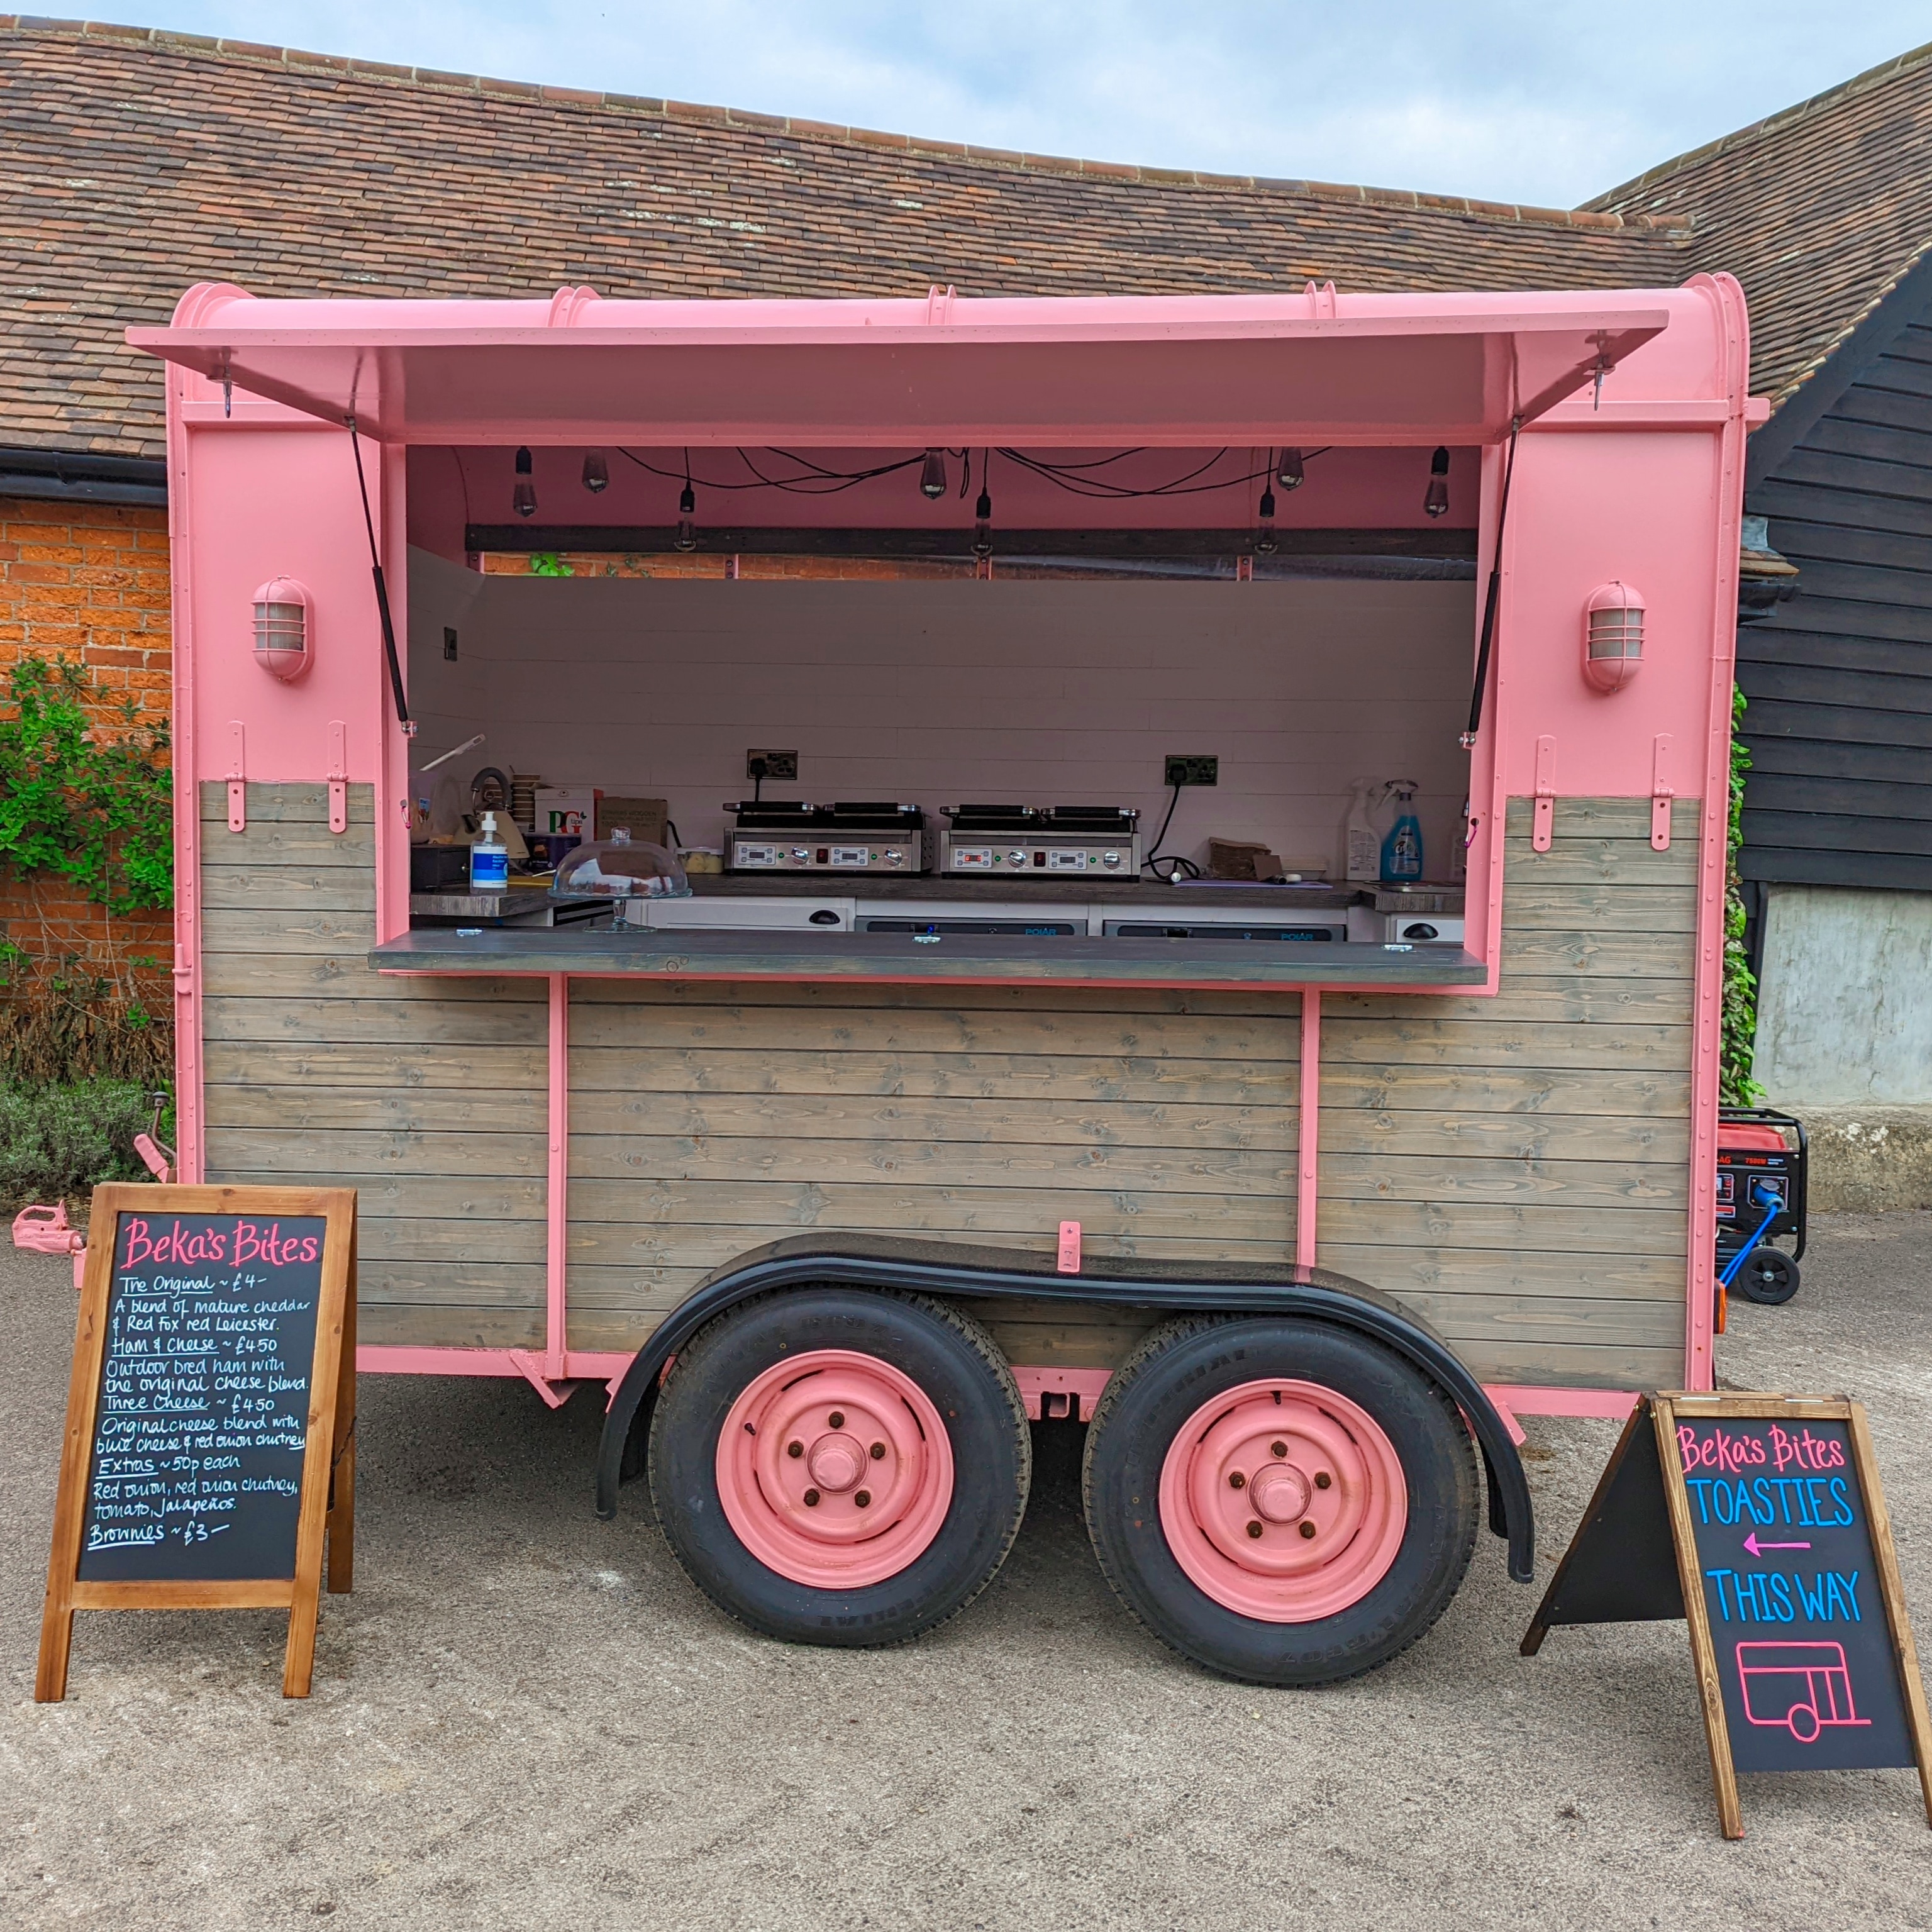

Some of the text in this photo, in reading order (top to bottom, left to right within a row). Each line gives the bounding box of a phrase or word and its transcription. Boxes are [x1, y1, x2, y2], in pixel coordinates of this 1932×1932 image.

[547, 811, 580, 833] PG
[120, 1218, 318, 1269] Beka's Bites
[119, 1277, 148, 1293] The
[153, 1275, 215, 1298] Original
[115, 1299, 311, 1319] A blend of mature cheddar
[127, 1317, 153, 1332] Red
[158, 1316, 179, 1333] Fox
[187, 1317, 210, 1331] red
[111, 1337, 148, 1355] Ham
[167, 1337, 218, 1352] Cheese
[106, 1355, 285, 1377] Outdoor bred ham with
[104, 1377, 133, 1393] the
[140, 1376, 209, 1397] original
[214, 1376, 265, 1391] cheese
[103, 1395, 148, 1410] Three
[153, 1396, 210, 1411] Cheese
[102, 1414, 300, 1441] Original cheese blend with
[96, 1438, 132, 1455] blue
[136, 1437, 182, 1453] cheese
[195, 1434, 213, 1448] red
[216, 1432, 252, 1448] onion
[256, 1433, 306, 1450] chutney
[1675, 1424, 1846, 1474] Beka's Bites
[99, 1458, 155, 1475] Extras
[203, 1454, 241, 1470] each
[94, 1474, 298, 1500] Red onion, red onion chutney,
[94, 1501, 153, 1519] tomato,
[1686, 1477, 1855, 1527] TOASTIES
[87, 1524, 165, 1546] Brownies
[1706, 1569, 1862, 1623] THIS WAY
